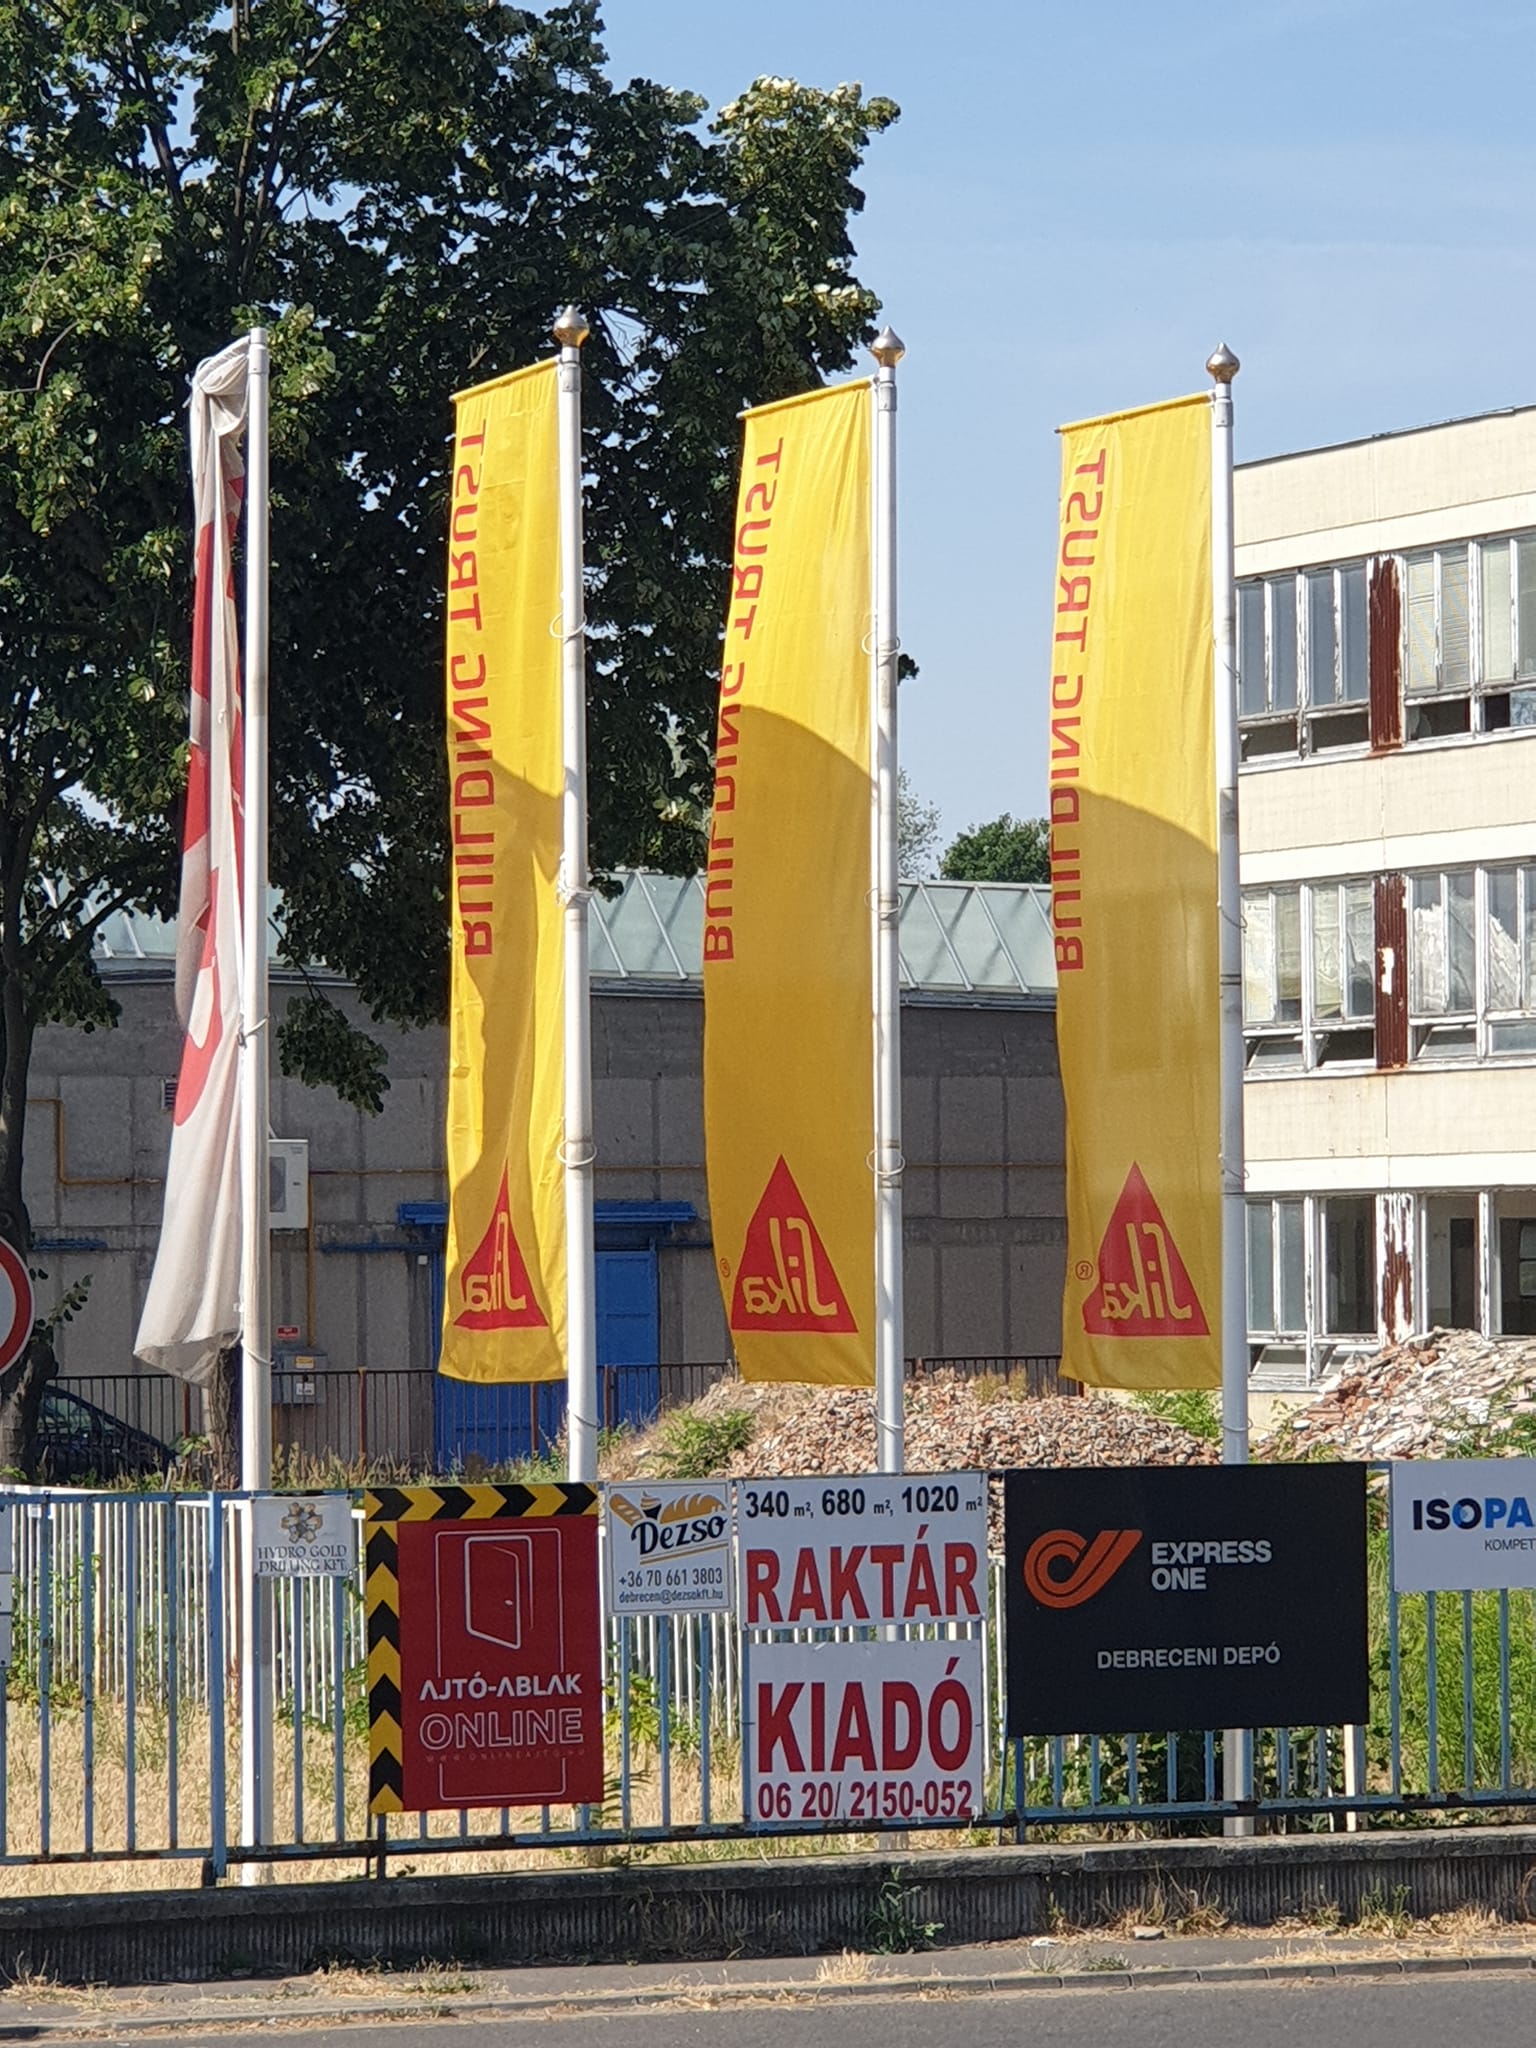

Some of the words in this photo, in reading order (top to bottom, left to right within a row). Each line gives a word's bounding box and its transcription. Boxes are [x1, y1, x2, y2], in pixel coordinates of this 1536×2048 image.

[745, 1491, 789, 1518] 340
[821, 1488, 865, 1516] 680
[901, 1485, 959, 1513] 1020
[257, 1545, 307, 1559] HYDRO
[309, 1544, 347, 1558] GOLD
[1151, 1540, 1273, 1565] EXPRESS
[619, 1570, 643, 1587] +36
[647, 1569, 662, 1586] 70
[666, 1568, 687, 1585] 661
[692, 1567, 723, 1585] 3803
[745, 1524, 981, 1623] RAKTÁR
[1151, 1567, 1207, 1590] ONE
[1097, 1648, 1217, 1669] DEBRECENI
[1223, 1641, 1281, 1665] DEPÓ
[419, 1708, 584, 1750] ONLINE
[758, 1657, 973, 1773] KIADÓ
[758, 1782, 791, 1818] 06
[850, 1780, 972, 1817] 2150-052
